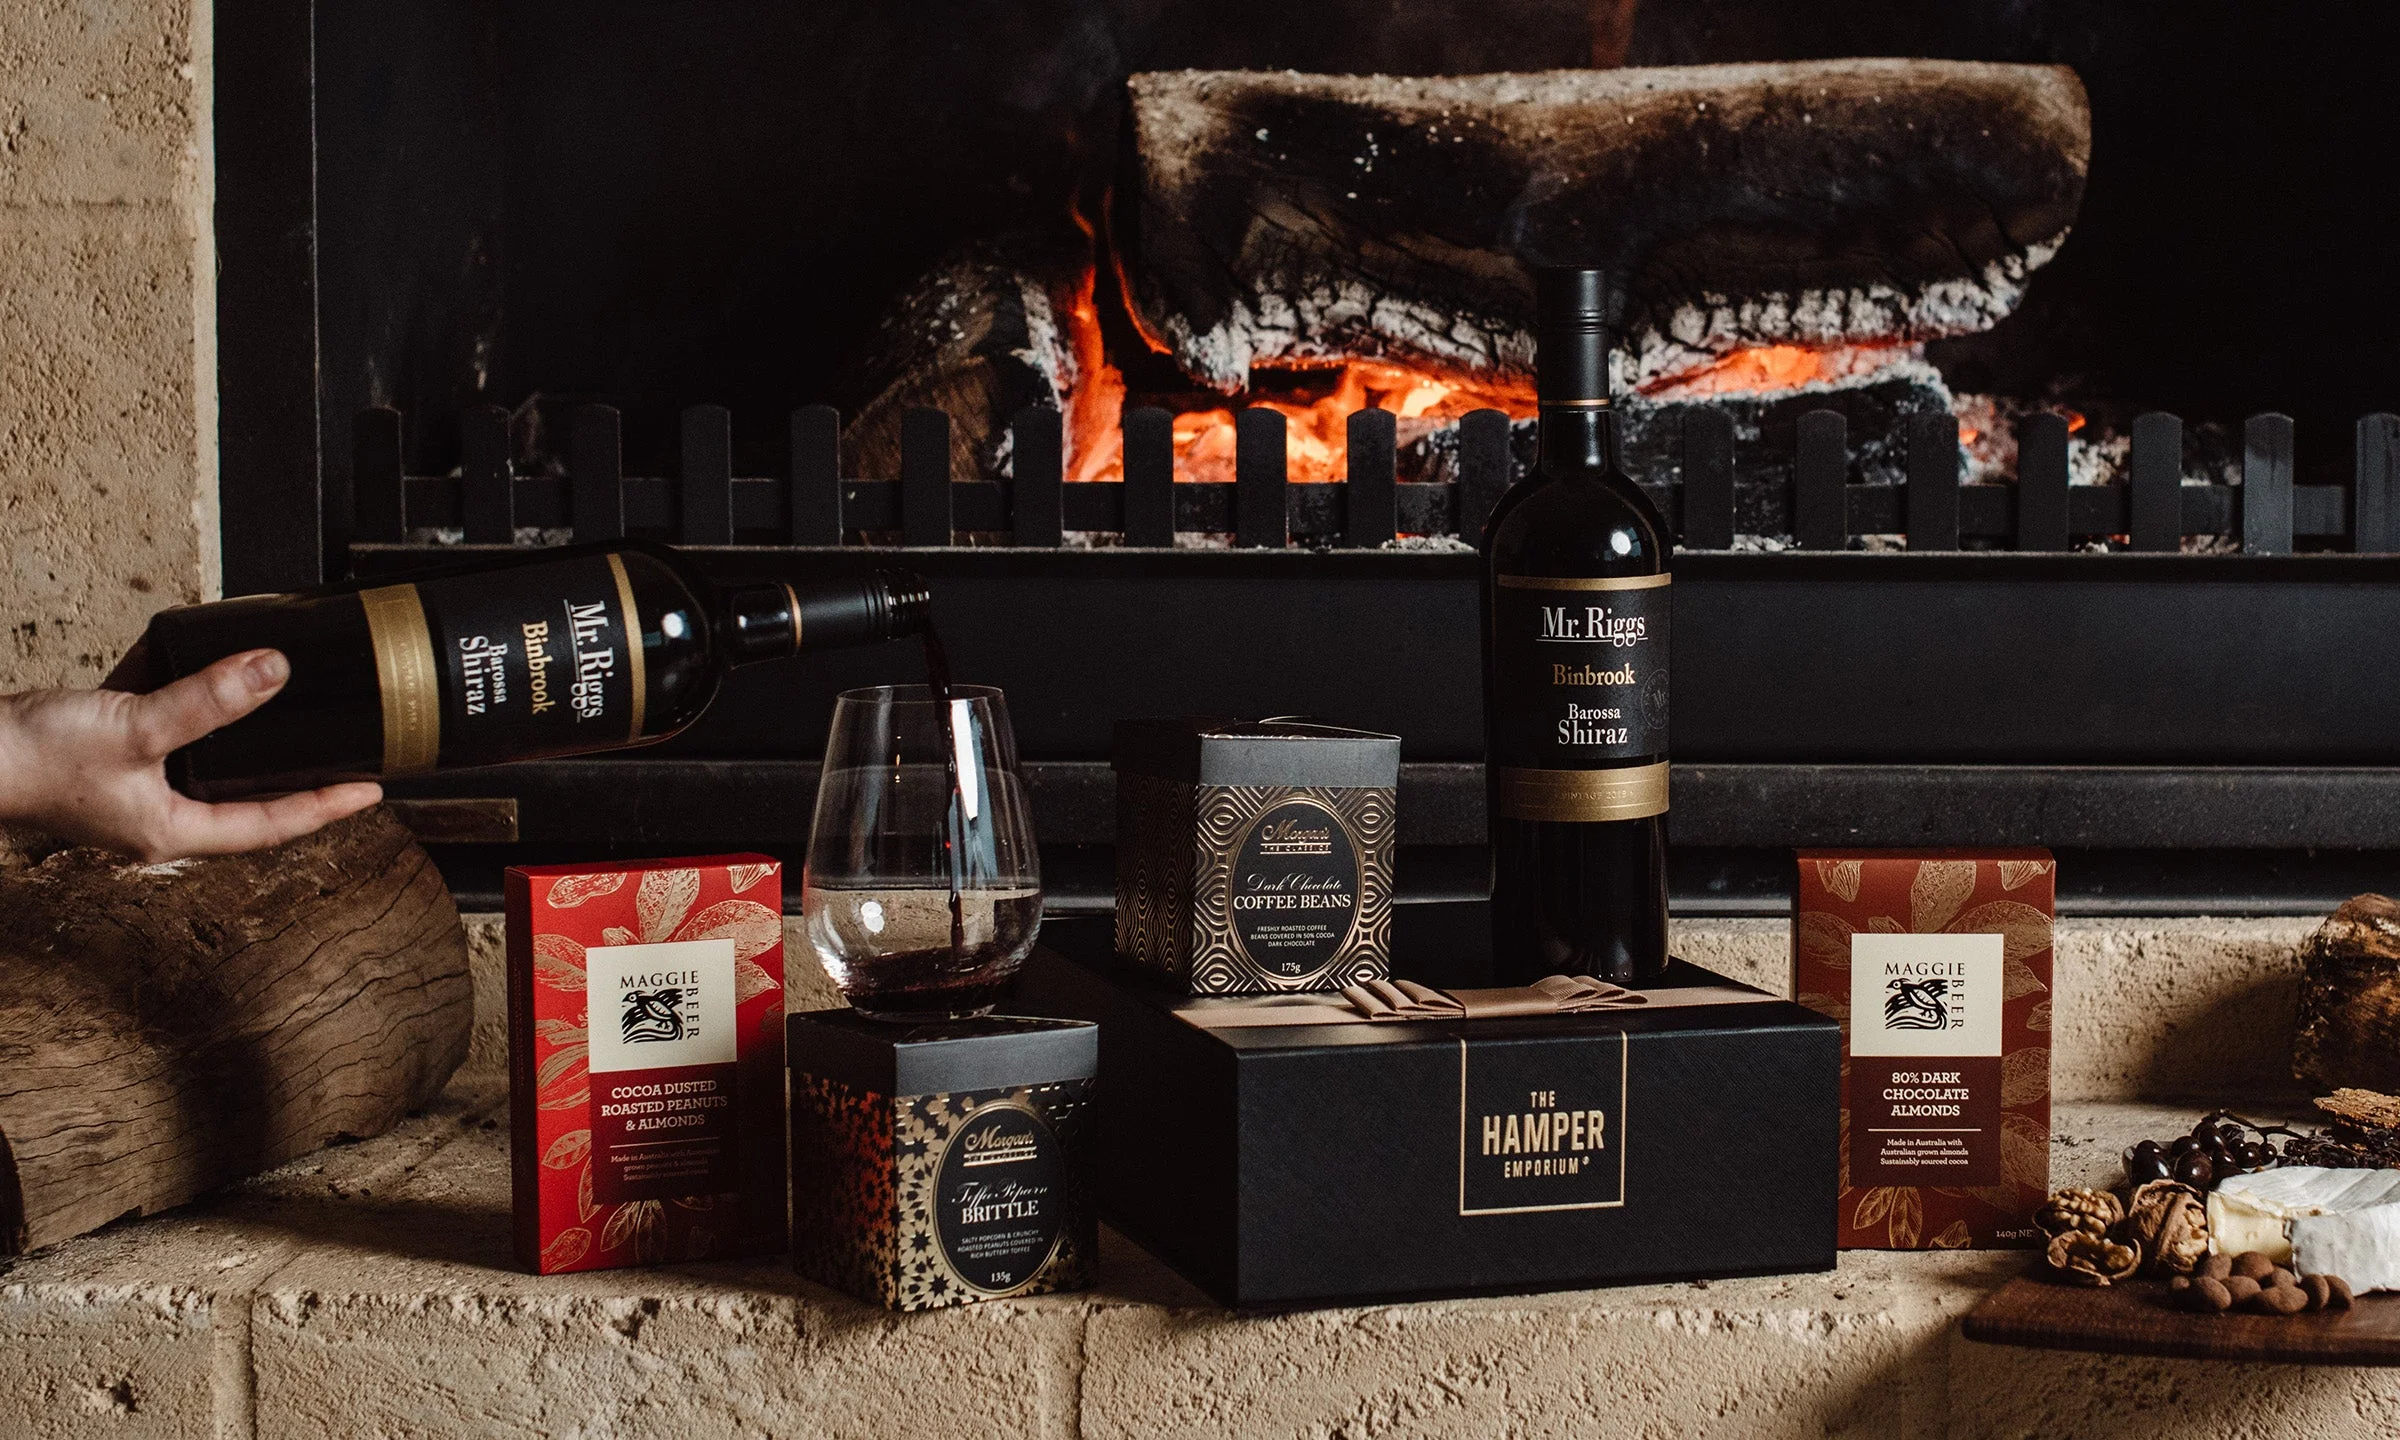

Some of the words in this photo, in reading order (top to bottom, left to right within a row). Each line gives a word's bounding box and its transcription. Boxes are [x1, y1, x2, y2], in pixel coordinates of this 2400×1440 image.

[570, 600, 609, 646] Mr.
[1541, 607, 1580, 639] Mr.
[1585, 607, 1645, 647] Riggs
[459, 635, 489, 716] Shiraz
[489, 643, 508, 704] Barossa
[522, 621, 555, 715] Binbrook
[1553, 663, 1636, 686] Binbrook
[571, 647, 614, 718] Riggs
[1568, 704, 1621, 720] Barossa
[1558, 719, 1628, 744] Shiraz
[1247, 873, 1287, 892] Dark
[1286, 872, 1343, 891] Chocolate
[1233, 895, 1297, 910] COFFEE
[1300, 894, 1352, 909] BEANS
[1281, 962, 1301, 973] 175g
[1885, 962, 1965, 975] MAGGIE
[620, 970, 700, 989] MAGGIE
[685, 987, 700, 1040] BEER
[1951, 979, 1965, 1030] BEER
[1892, 1072, 1919, 1084] 80%
[1921, 1072, 1961, 1084] DARK
[611, 1084, 662, 1099] COCOA
[664, 1080, 717, 1095] DUSTED
[1530, 1090, 1556, 1108] THE
[1883, 1089, 1969, 1100] CHOCOLATE
[601, 1101, 665, 1117] ROASTED
[667, 1095, 728, 1111] PEANUTS
[1891, 1105, 1960, 1116] ALMONDS
[625, 1120, 636, 1132] &
[638, 1114, 705, 1130] ALMONDS
[965, 1125, 1034, 1151] Morgan's
[1482, 1110, 1605, 1156] HAMPER
[1887, 1138, 1906, 1146] Made
[1907, 1138, 1914, 1146] in
[1915, 1138, 1946, 1146] Australia
[1947, 1138, 1963, 1146] with
[1939, 1147, 1969, 1155] almonds
[1880, 1158, 1920, 1166] Sustainably
[1921, 1157, 1947, 1165] sourced
[961, 1200, 1039, 1224] BRITTLE
[957, 1243, 983, 1252] ROASTED
[1010, 1237, 1036, 1246] COVERED
[979, 1233, 1006, 1242] POPCORN
[1996, 1230, 2017, 1240] 140g
[991, 1272, 1011, 1283] 135g
